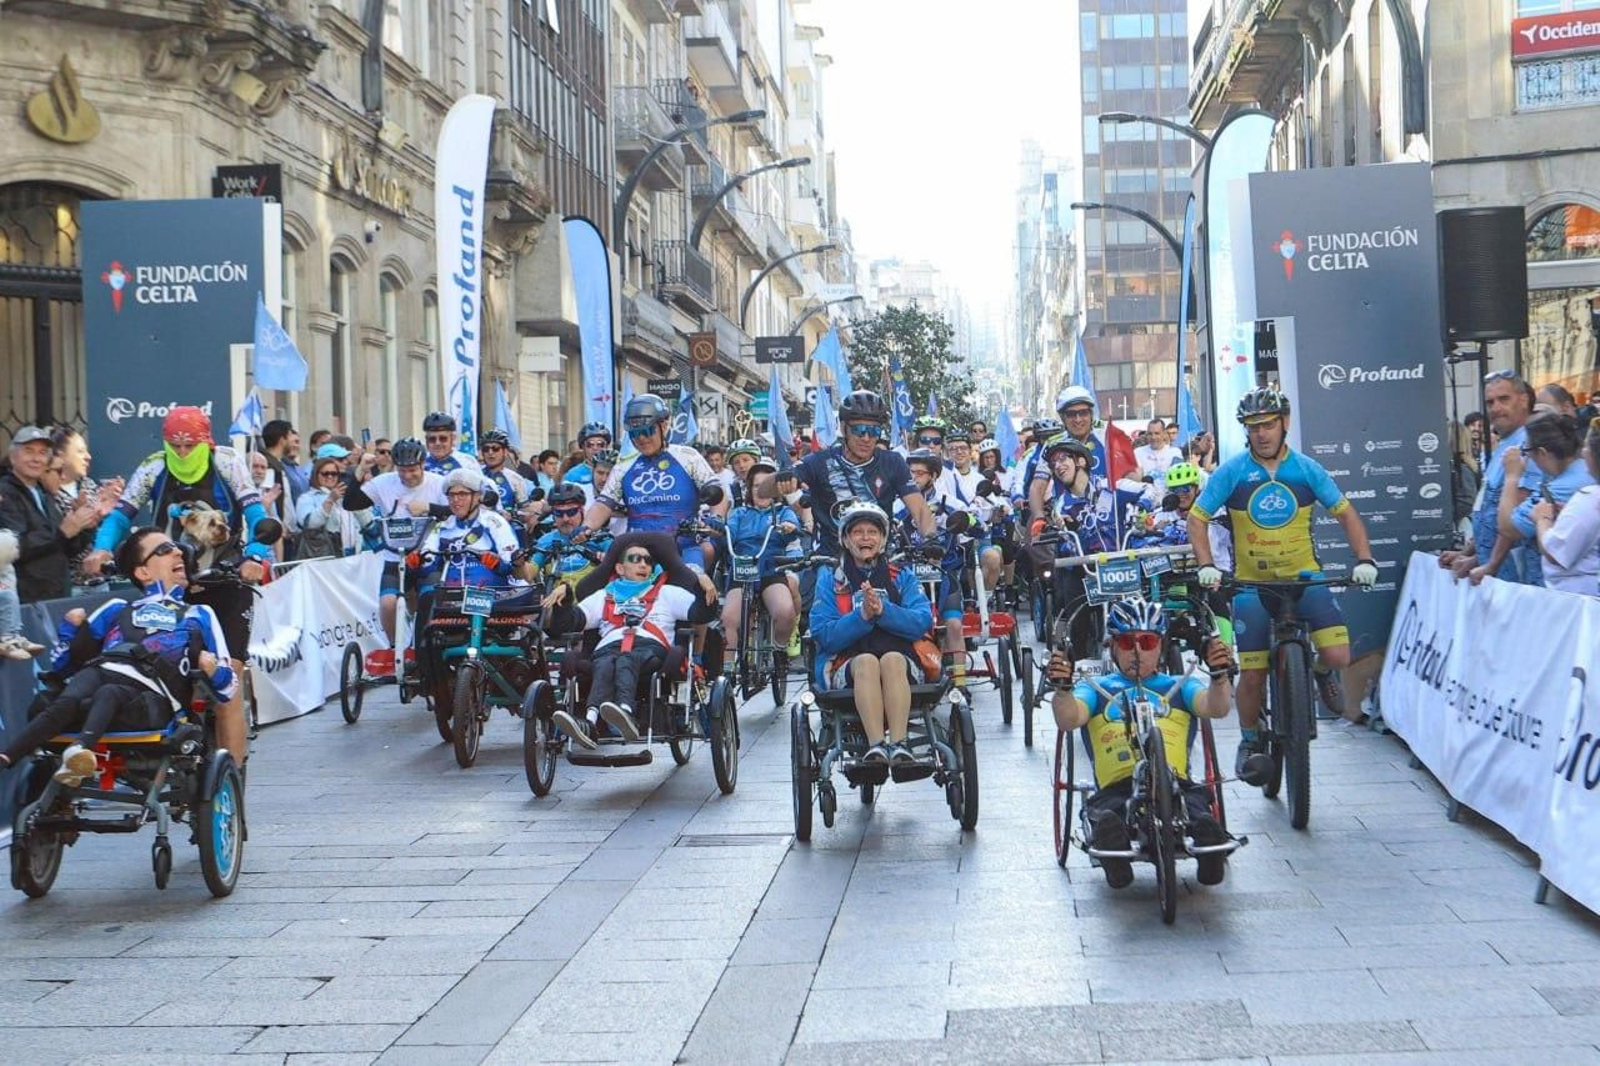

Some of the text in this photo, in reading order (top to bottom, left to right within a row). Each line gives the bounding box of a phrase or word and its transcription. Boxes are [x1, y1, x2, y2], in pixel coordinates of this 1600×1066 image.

[1539, 21, 1600, 40] Occiden
[222, 176, 259, 189] Work
[1307, 226, 1419, 251] FUNDACIÓN
[1307, 252, 1369, 271] CELTA
[136, 261, 248, 283] FUNDACIÓN
[453, 184, 475, 368] Profand
[136, 285, 198, 303] CELTA
[1350, 364, 1425, 383] Profand
[628, 493, 681, 505] DisCamino
[1102, 570, 1138, 584] 10015
